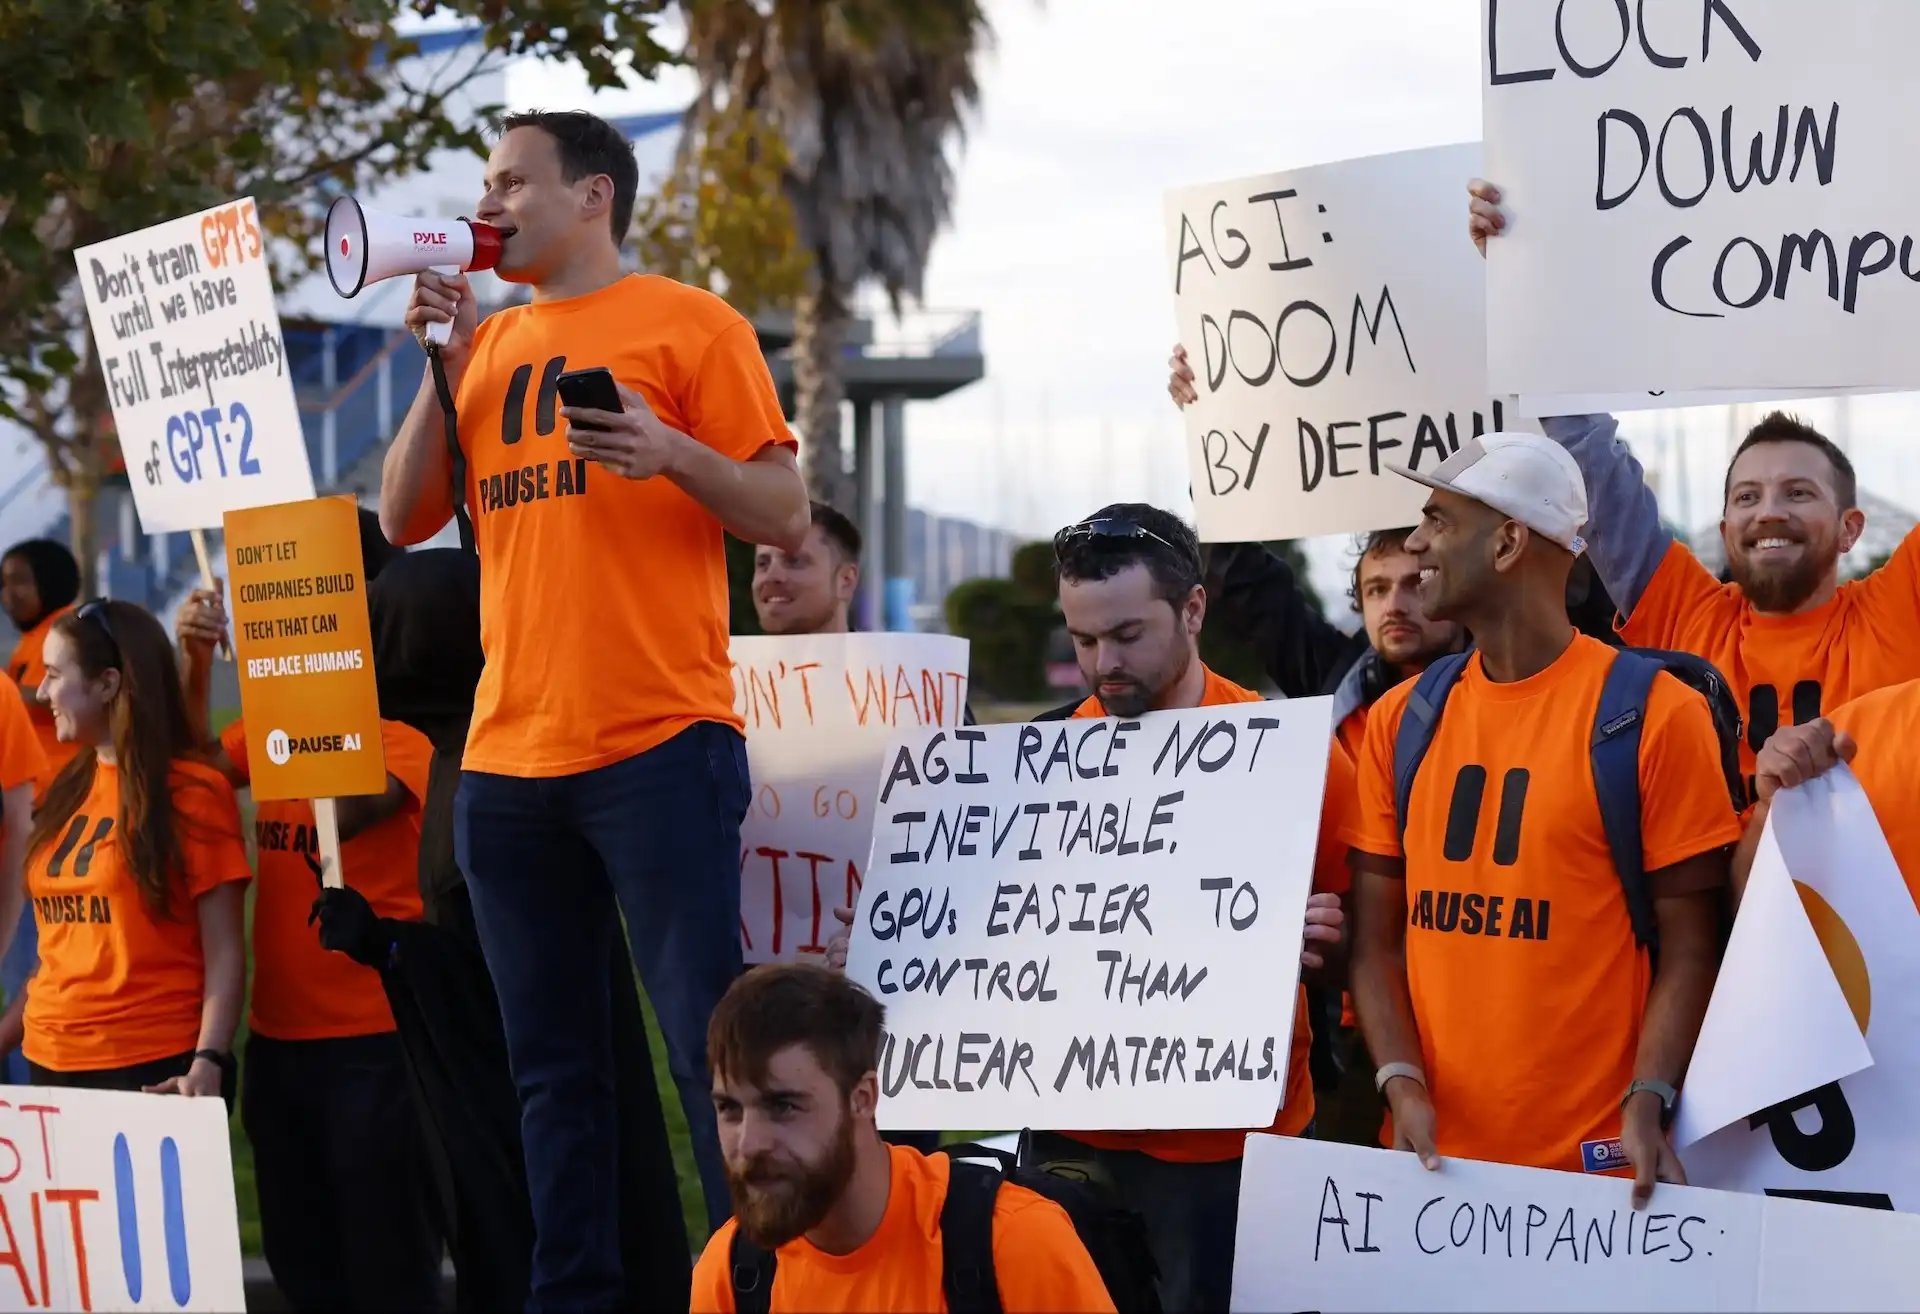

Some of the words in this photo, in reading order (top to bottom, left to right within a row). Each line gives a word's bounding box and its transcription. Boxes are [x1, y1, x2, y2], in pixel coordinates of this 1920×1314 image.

[1596, 102, 1839, 210] DOWN
[90, 251, 144, 303] Don't
[147, 242, 201, 285] train
[201, 202, 262, 268] GPT-5
[413, 232, 447, 244] PYLE
[1174, 188, 1334, 295] AGI:
[110, 295, 154, 340] until
[160, 292, 187, 325] we
[190, 276, 237, 315] have
[1201, 284, 1416, 393] DOOM
[105, 348, 150, 408] Full
[144, 440, 162, 486] of
[166, 402, 262, 483] GPT-2
[1201, 423, 1270, 496] BY
[479, 463, 550, 515] PAUSE
[555, 458, 587, 497] AI
[236, 543, 273, 566] DON'T
[276, 541, 297, 561] LET
[240, 577, 313, 604] COMPANIES
[316, 573, 354, 595] BUILD
[244, 620, 274, 641] TECH
[277, 617, 308, 638] THAT
[312, 613, 338, 634] CAN
[247, 655, 301, 679] REPLACE
[304, 649, 363, 673] HUMANS
[845, 664, 968, 729] WANT
[880, 729, 990, 804] AGI
[1014, 720, 1141, 785] RACE
[1153, 717, 1280, 778] NOT
[813, 783, 858, 820] GO
[890, 790, 1185, 864] INEVITABLE.
[89, 896, 111, 924] AI
[986, 881, 1154, 936] EASIER
[1200, 877, 1260, 931] TO
[1508, 898, 1551, 940] AI
[877, 955, 1057, 1002] CONTROL
[1097, 950, 1208, 1007] THAN
[1053, 1034, 1279, 1093] MATERIALS.
[1314, 1176, 1383, 1262] AI
[1415, 1196, 1726, 1264] COMPANIES:
